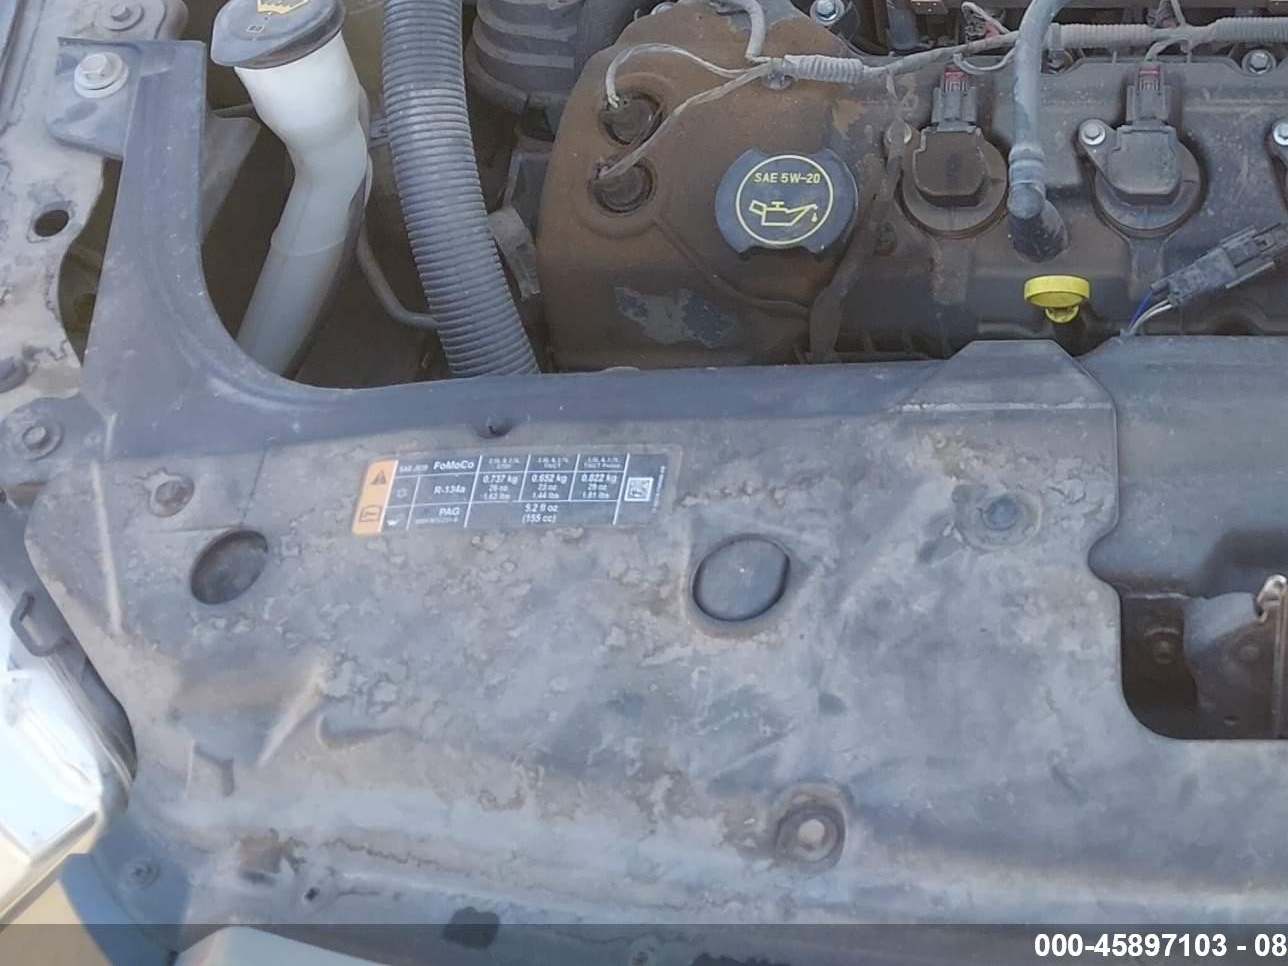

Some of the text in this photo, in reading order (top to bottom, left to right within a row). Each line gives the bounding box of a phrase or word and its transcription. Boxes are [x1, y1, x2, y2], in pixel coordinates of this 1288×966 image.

[754, 172, 821, 184] SAE 5W-20
[433, 459, 475, 470] FoMoCo
[482, 474, 519, 485] 0.737 kg
[556, 474, 568, 485] kg
[605, 473, 618, 484] kg
[433, 484, 467, 495] R-134a
[438, 506, 461, 517] PAG
[524, 503, 539, 513] 5.2
[547, 504, 559, 513] oz
